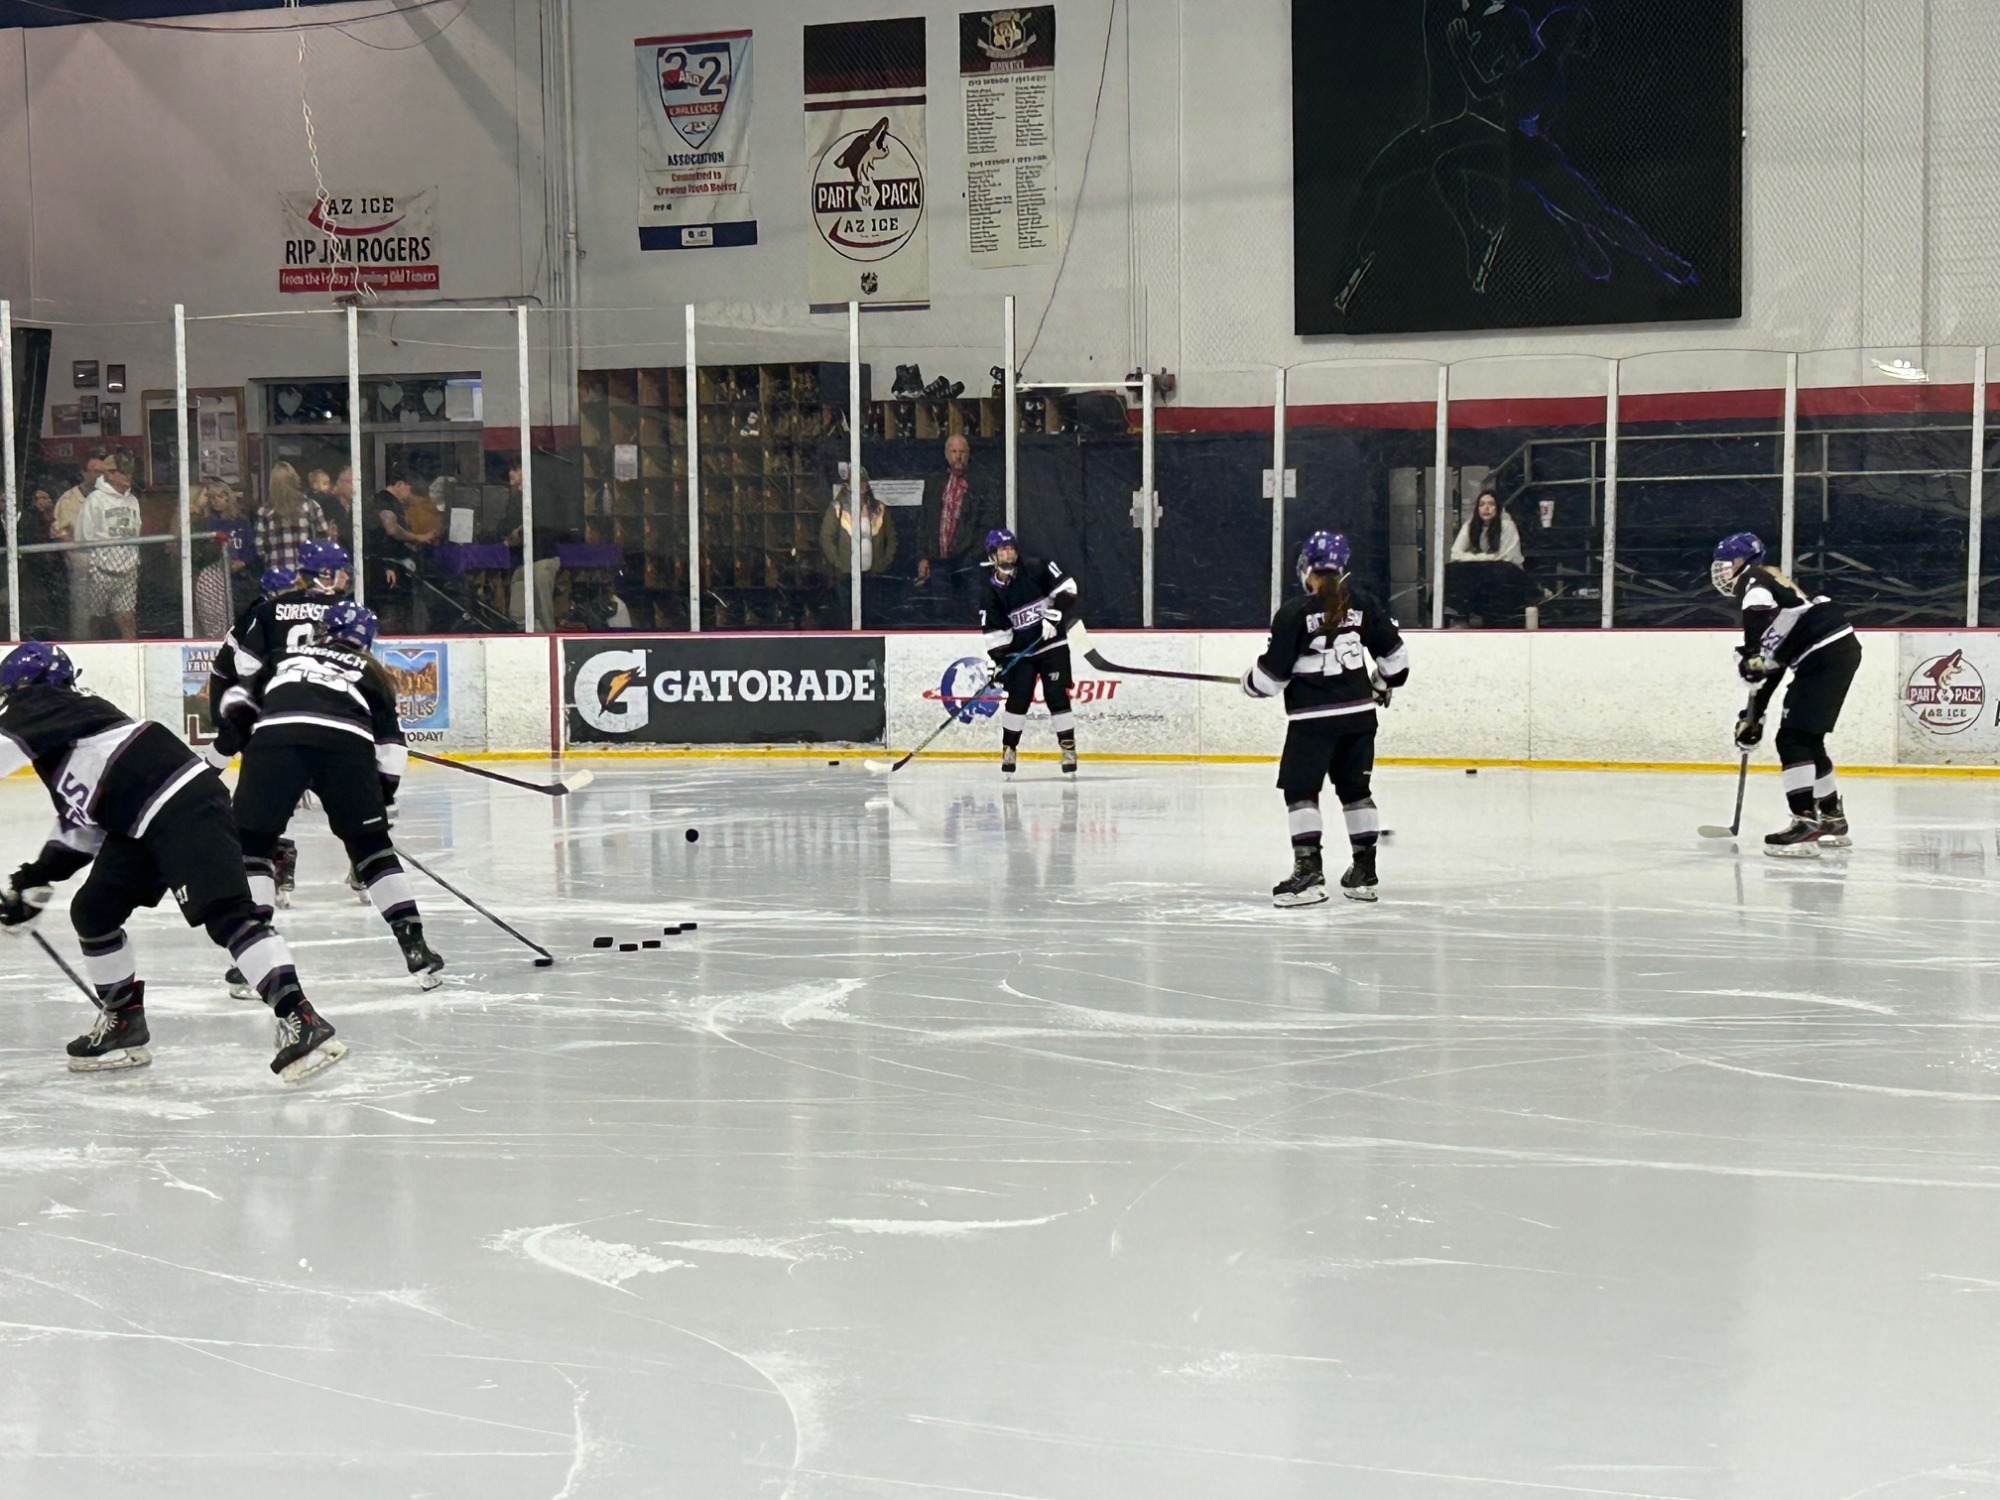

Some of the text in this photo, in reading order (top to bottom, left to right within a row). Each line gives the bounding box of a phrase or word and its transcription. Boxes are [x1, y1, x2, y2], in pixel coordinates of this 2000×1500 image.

[699, 56, 722, 96] 2
[667, 151, 724, 166] ASSOCIATION
[818, 186, 854, 209] PART
[881, 181, 919, 206] PACK
[328, 197, 394, 216] AZ ICE
[844, 217, 899, 233] AZ ICE
[286, 236, 431, 264] RIP JIM ROGERS
[321, 270, 349, 287] Frday
[653, 669, 876, 703] GATORADE
[1911, 687, 1981, 701] PART PACK
[1947, 708, 1967, 717] ICE
